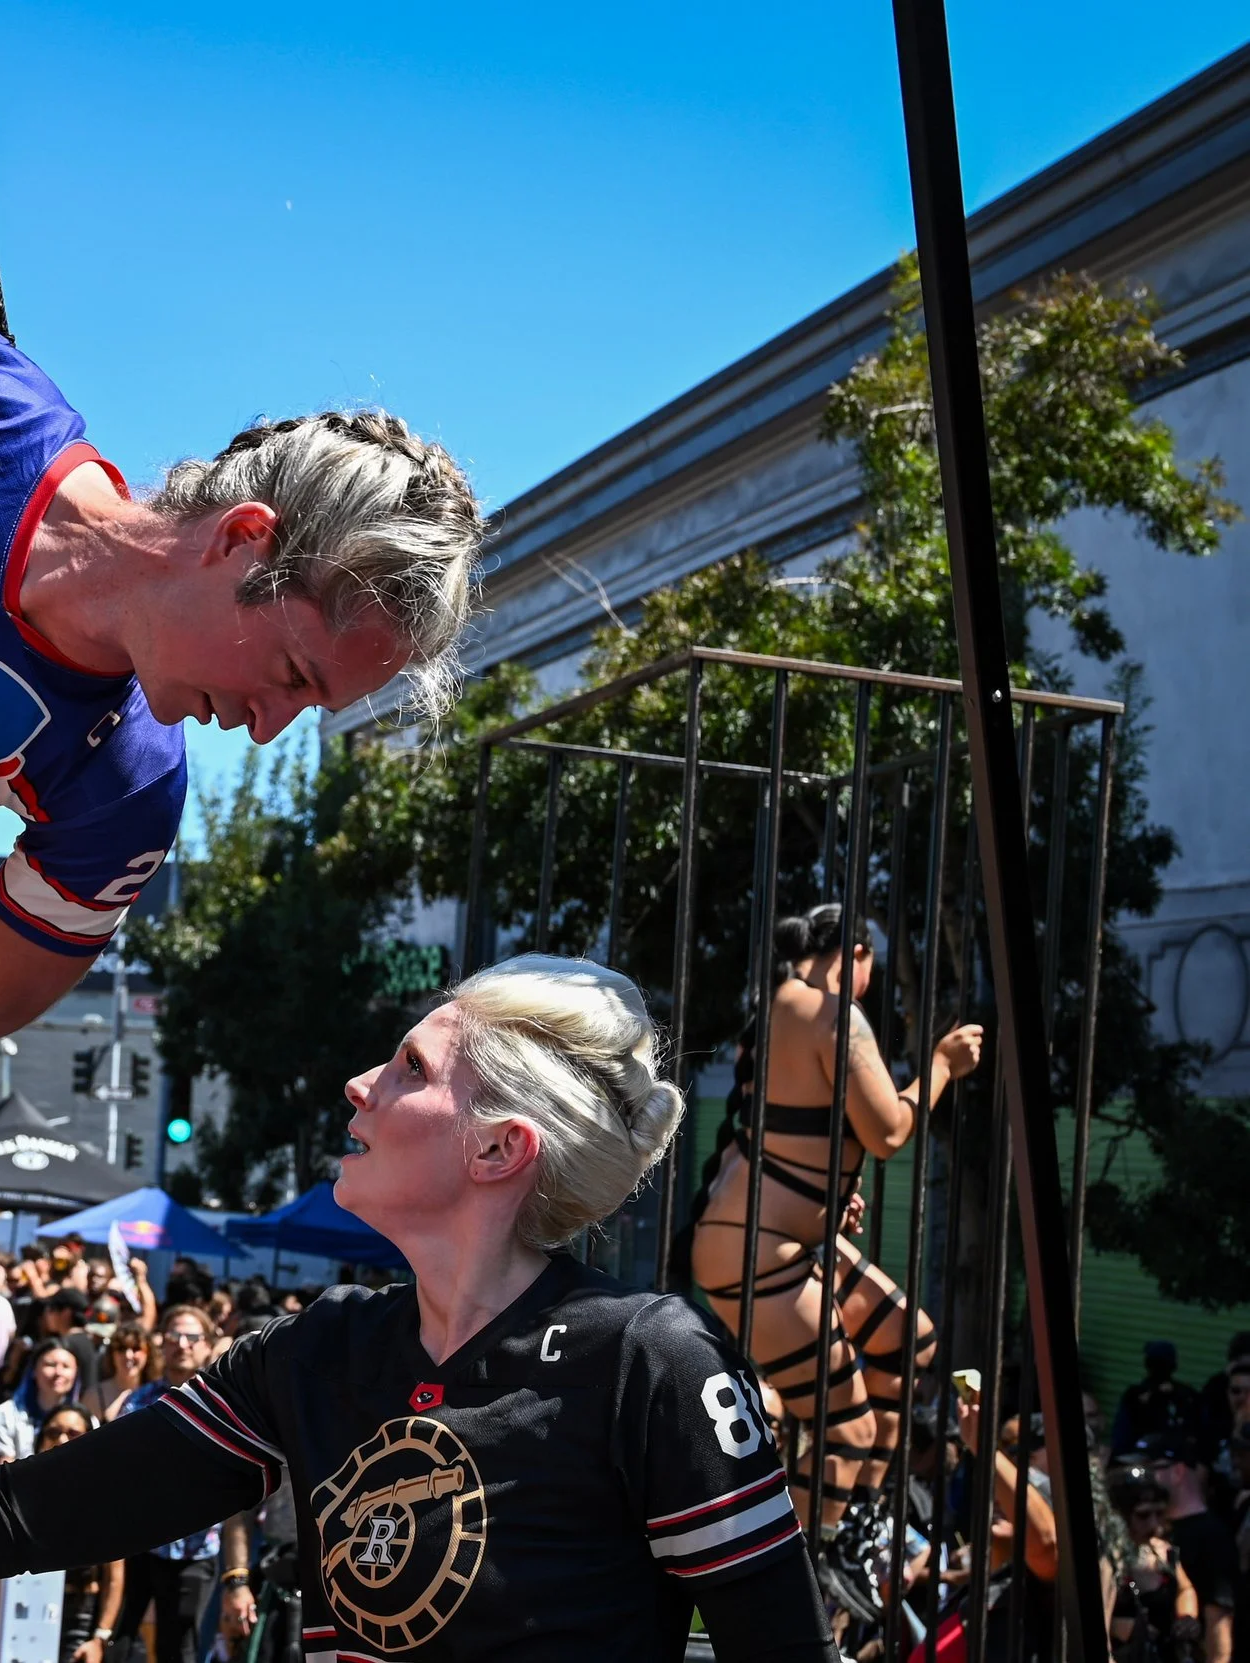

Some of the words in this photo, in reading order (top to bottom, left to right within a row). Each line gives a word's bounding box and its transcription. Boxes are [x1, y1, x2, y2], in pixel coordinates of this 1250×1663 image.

[94, 850, 166, 902] 2
[539, 1324, 568, 1362] C
[356, 1516, 398, 1566] R
